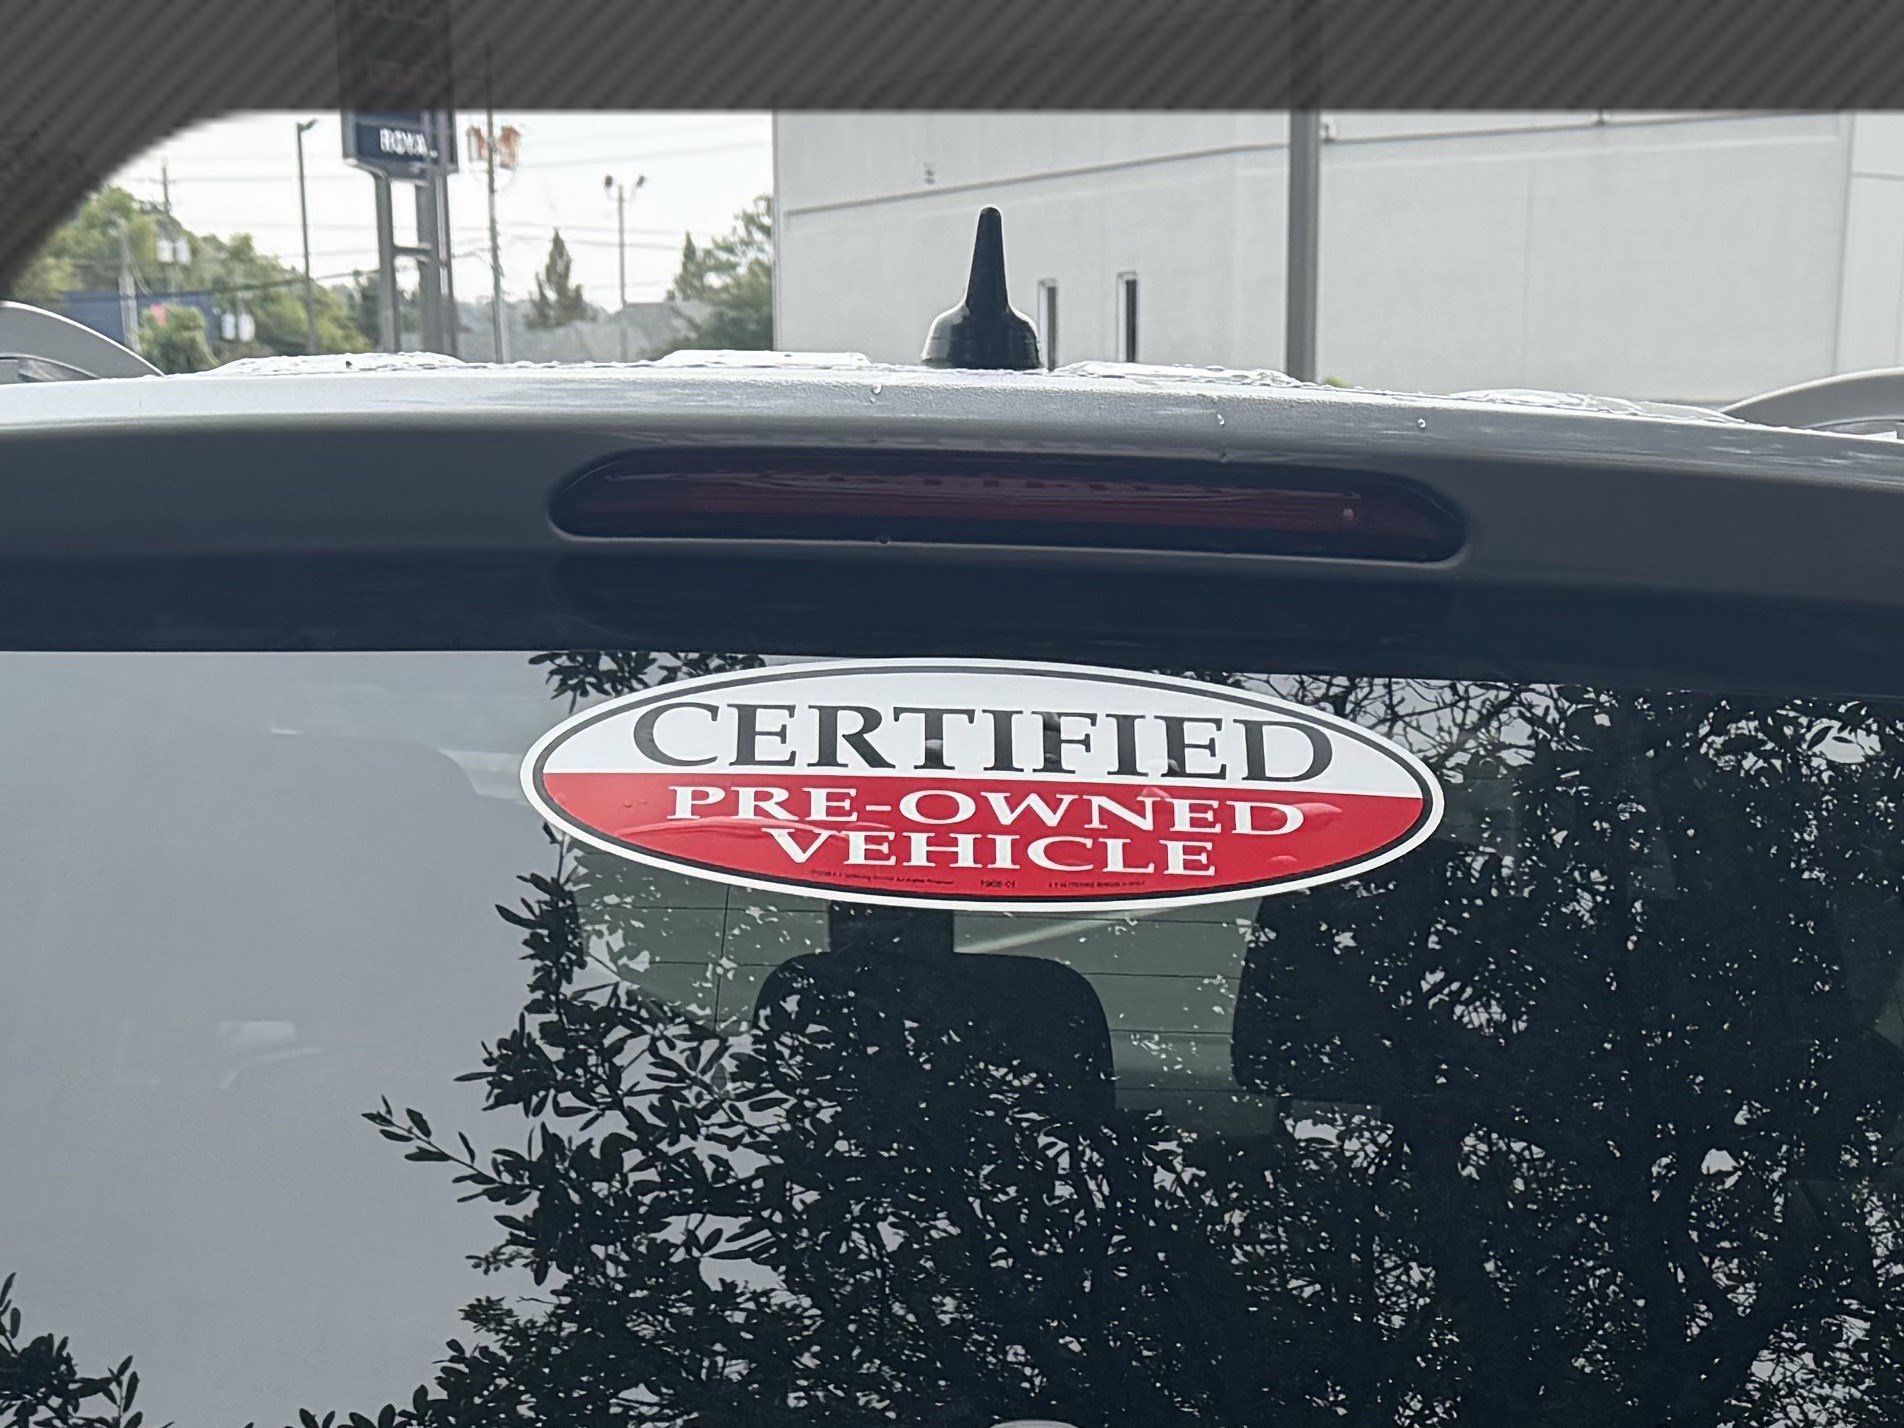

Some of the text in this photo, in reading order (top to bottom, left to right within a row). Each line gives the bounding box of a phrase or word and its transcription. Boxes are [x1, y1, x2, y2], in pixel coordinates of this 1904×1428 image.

[631, 701, 1335, 784] CERTIFIED
[666, 784, 1306, 837] PRE-OWNED
[759, 826, 1216, 878] VEHICLE
